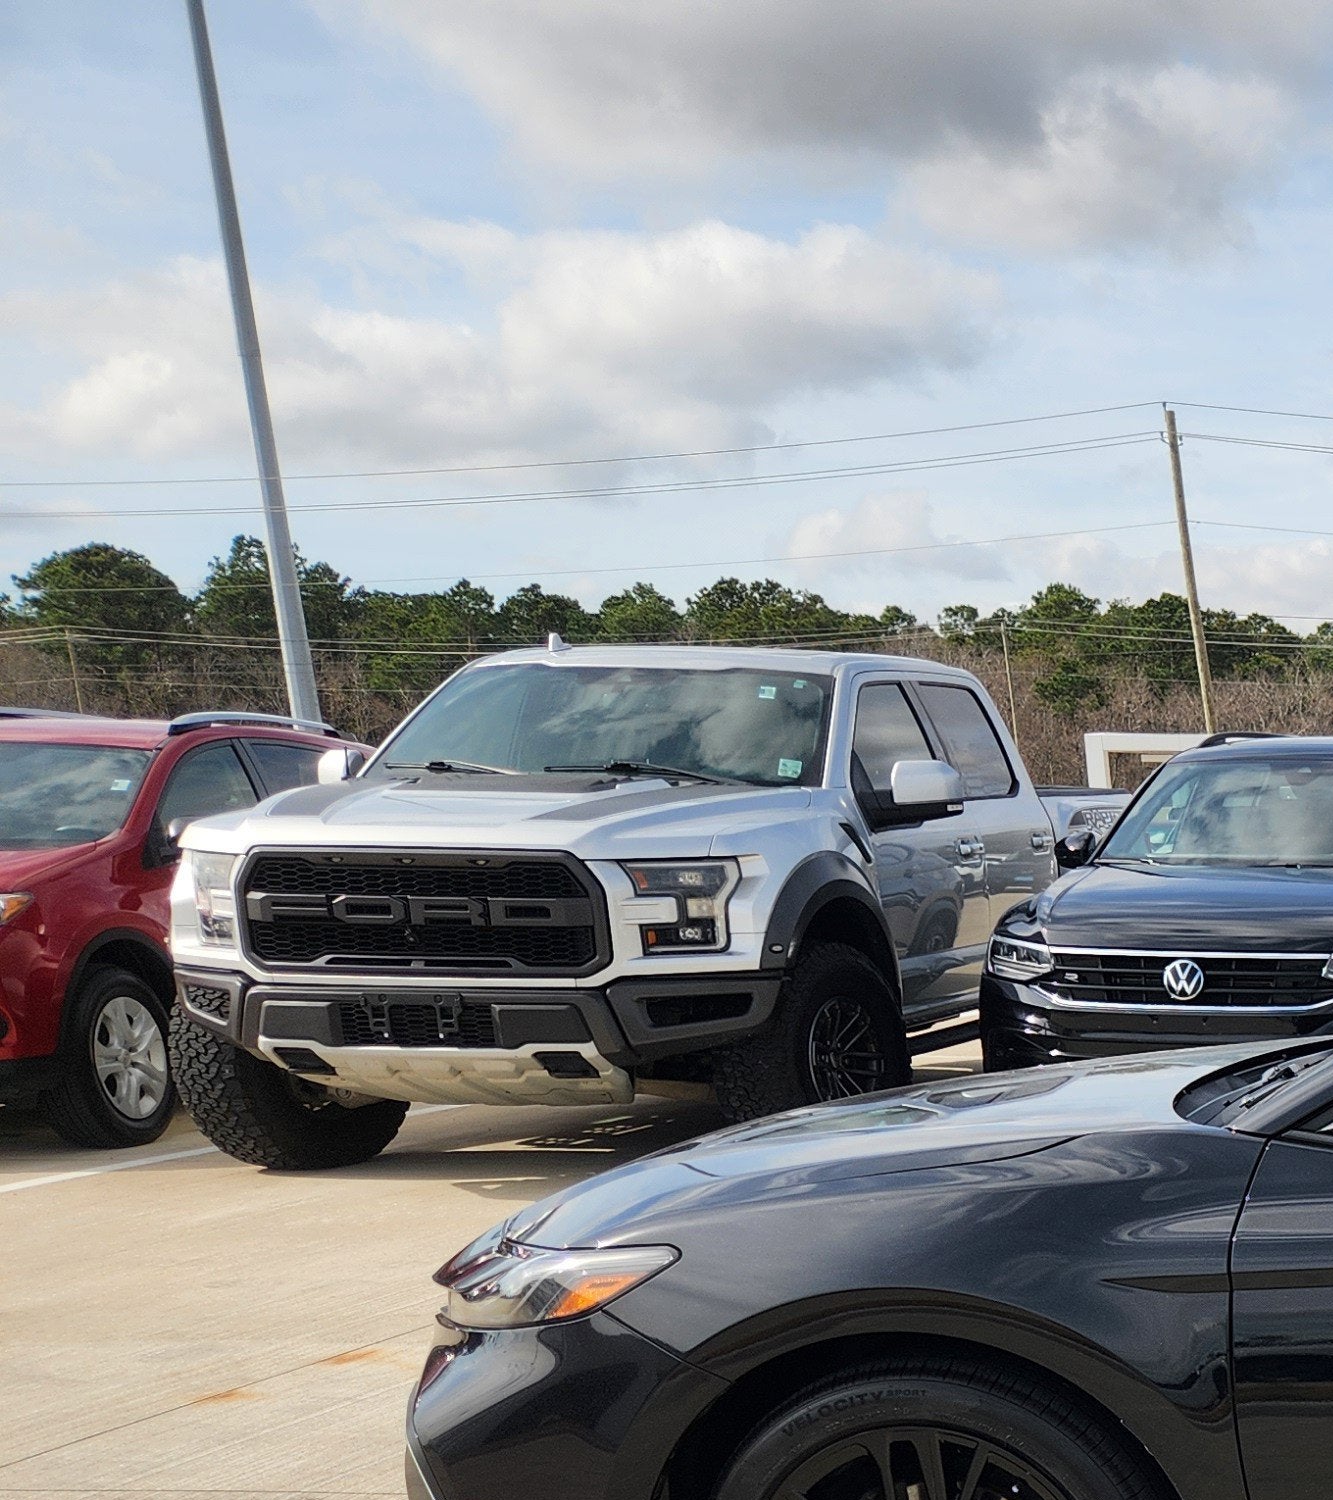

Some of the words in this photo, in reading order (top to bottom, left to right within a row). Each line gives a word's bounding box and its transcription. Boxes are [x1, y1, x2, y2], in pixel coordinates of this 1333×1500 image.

[247, 892, 575, 927] FORD
[1164, 959, 1204, 1000] VW
[782, 1390, 884, 1436] VELOCITY
[885, 1389, 927, 1397] SPORT
